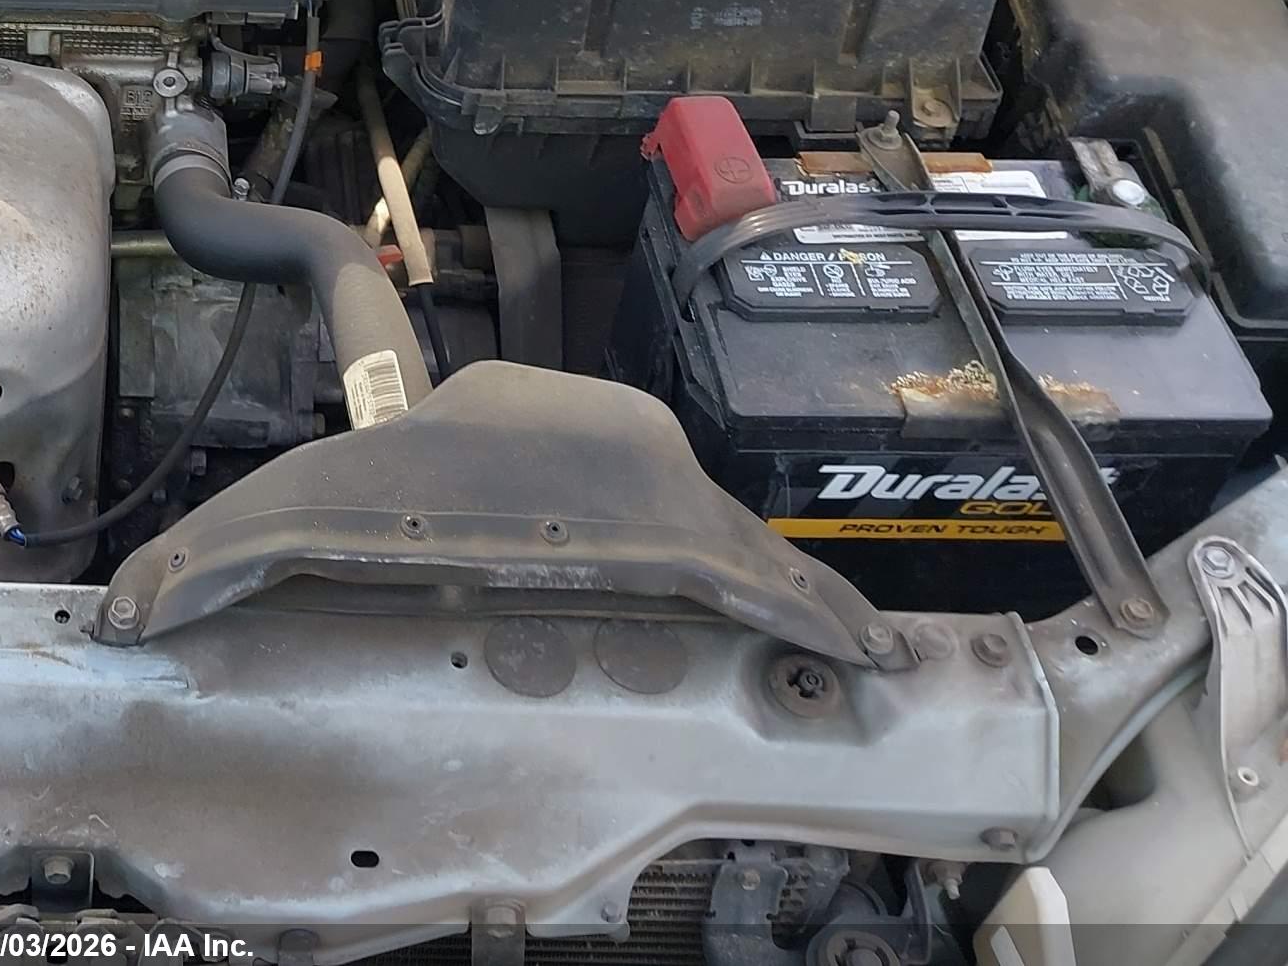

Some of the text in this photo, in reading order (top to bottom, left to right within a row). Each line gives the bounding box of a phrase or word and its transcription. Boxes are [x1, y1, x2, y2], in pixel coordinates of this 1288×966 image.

[773, 252, 826, 261] DANGER
[959, 501, 1052, 516] GOL
[839, 522, 1048, 535] PROVEN TOUGH
